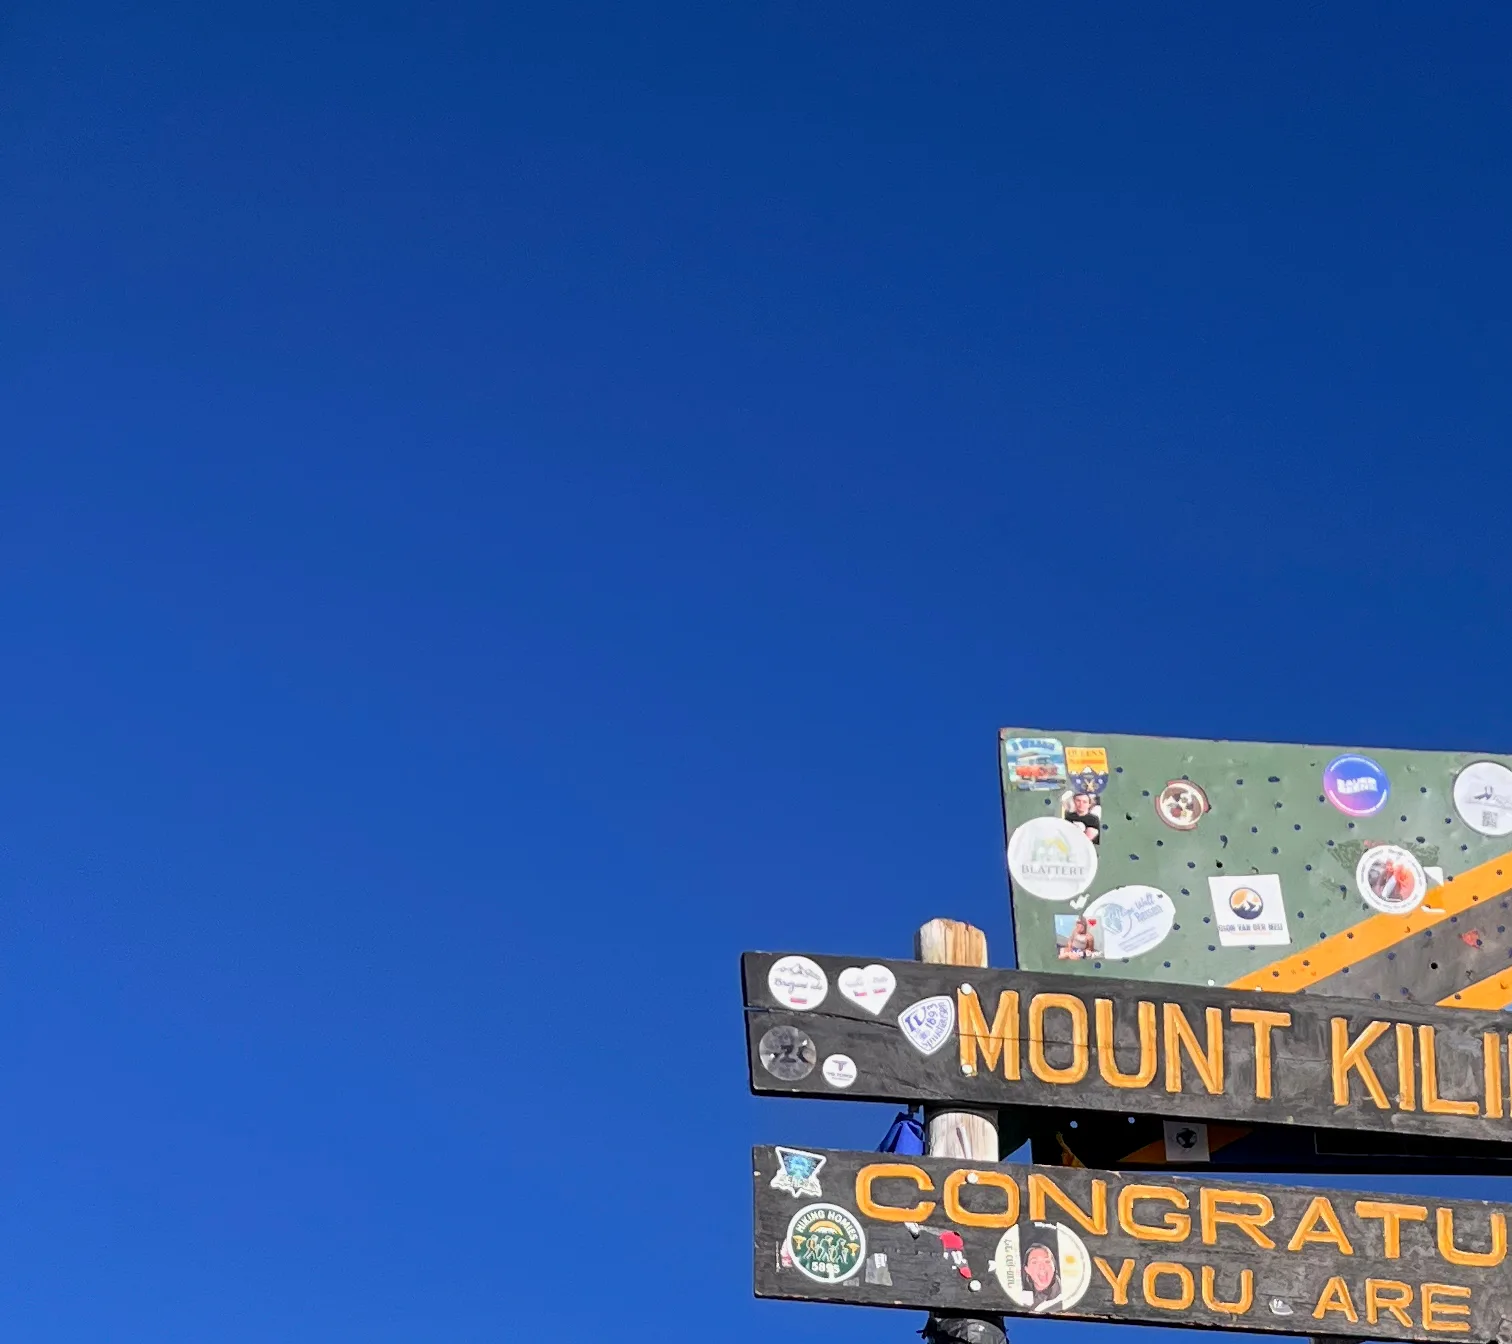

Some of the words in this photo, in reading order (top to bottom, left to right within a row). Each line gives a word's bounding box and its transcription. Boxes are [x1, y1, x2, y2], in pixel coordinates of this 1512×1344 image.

[1021, 864, 1085, 876] BLATTERT
[957, 986, 1293, 1101] MOUNT
[795, 1210, 827, 1233] HIKING
[827, 1210, 859, 1241] HOMIES
[1094, 1257, 1255, 1316] YOU
[1313, 1277, 1472, 1333] ARE
